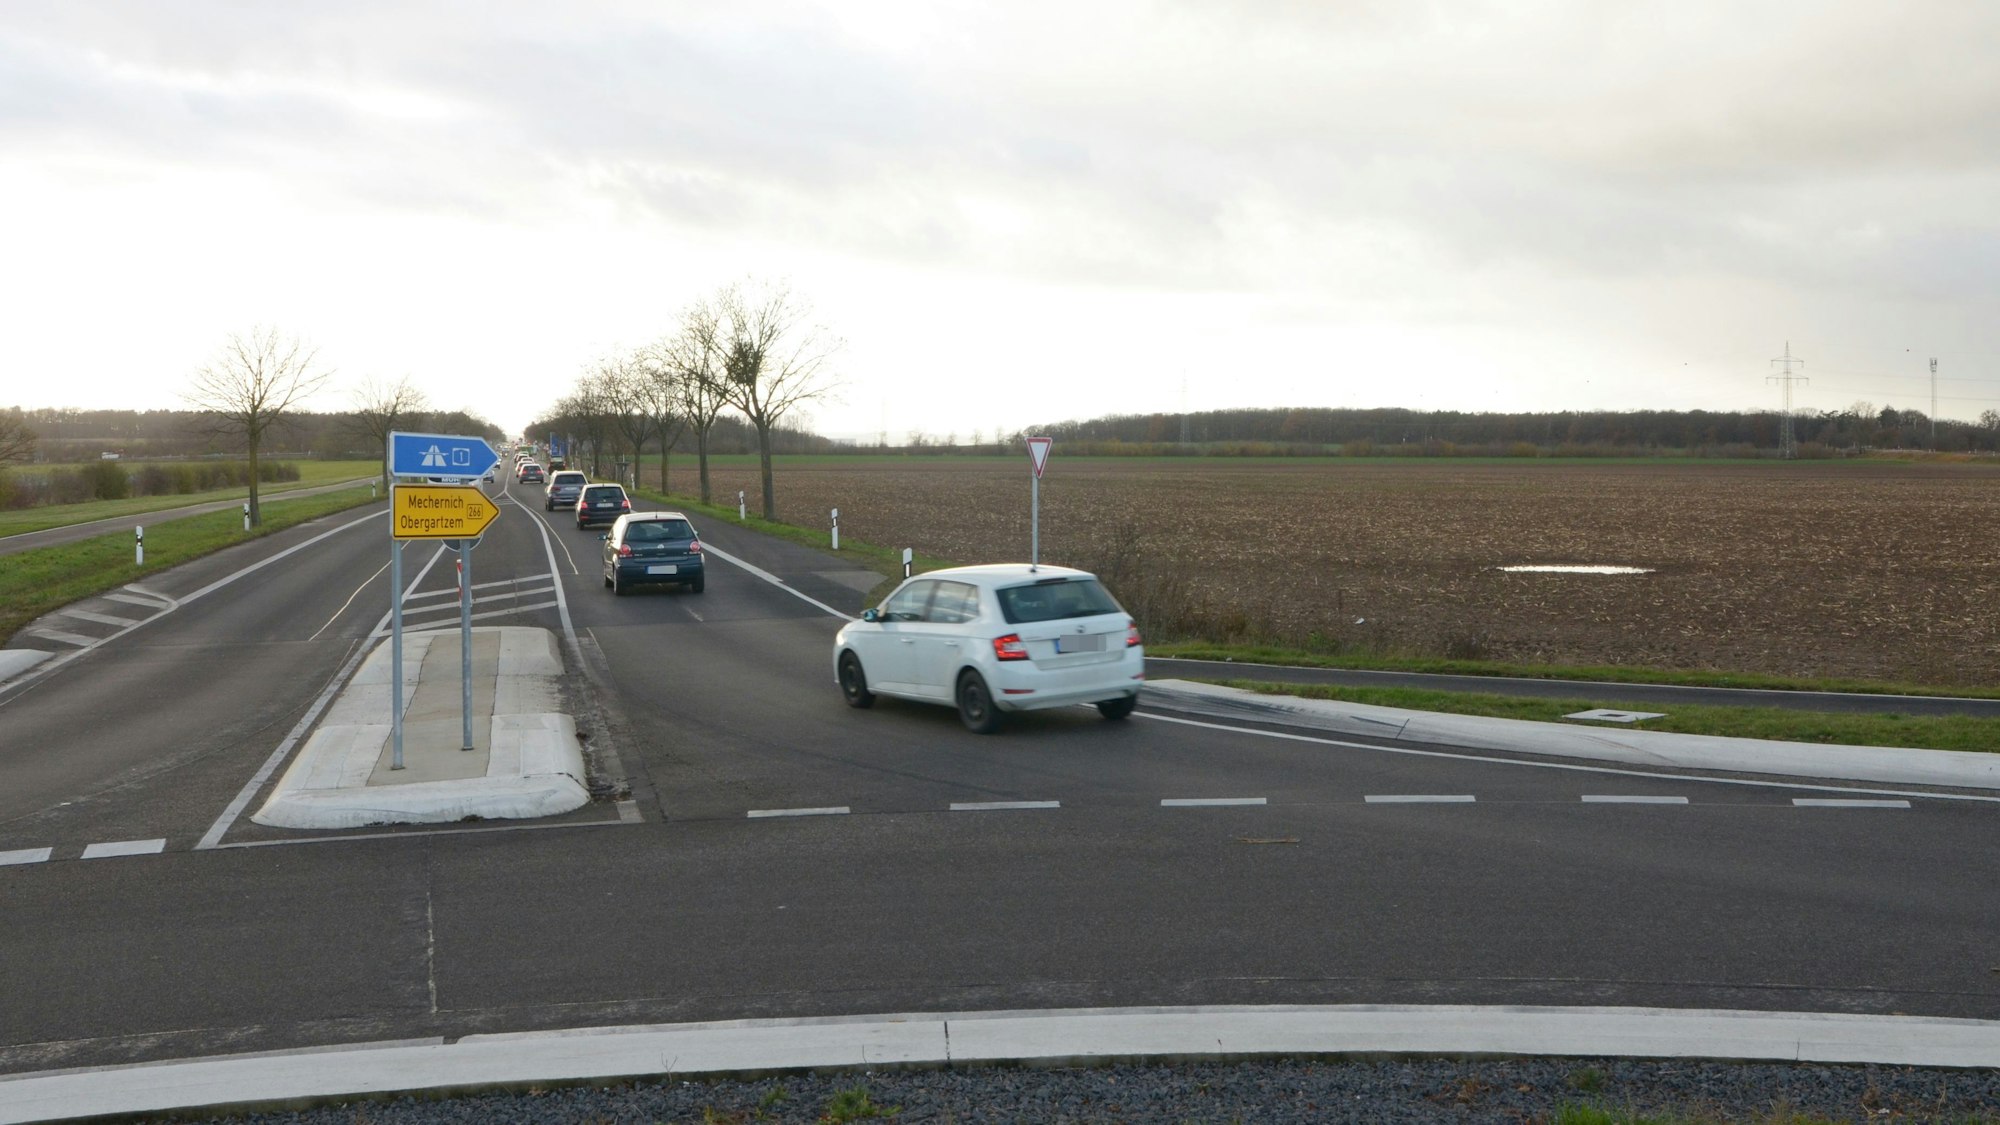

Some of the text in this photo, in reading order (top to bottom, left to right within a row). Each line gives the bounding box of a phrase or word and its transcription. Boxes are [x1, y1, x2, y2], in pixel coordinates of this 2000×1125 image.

[408, 495, 464, 509] Mechernich
[468, 506, 481, 517] 266
[400, 515, 464, 532] Obergartzem
